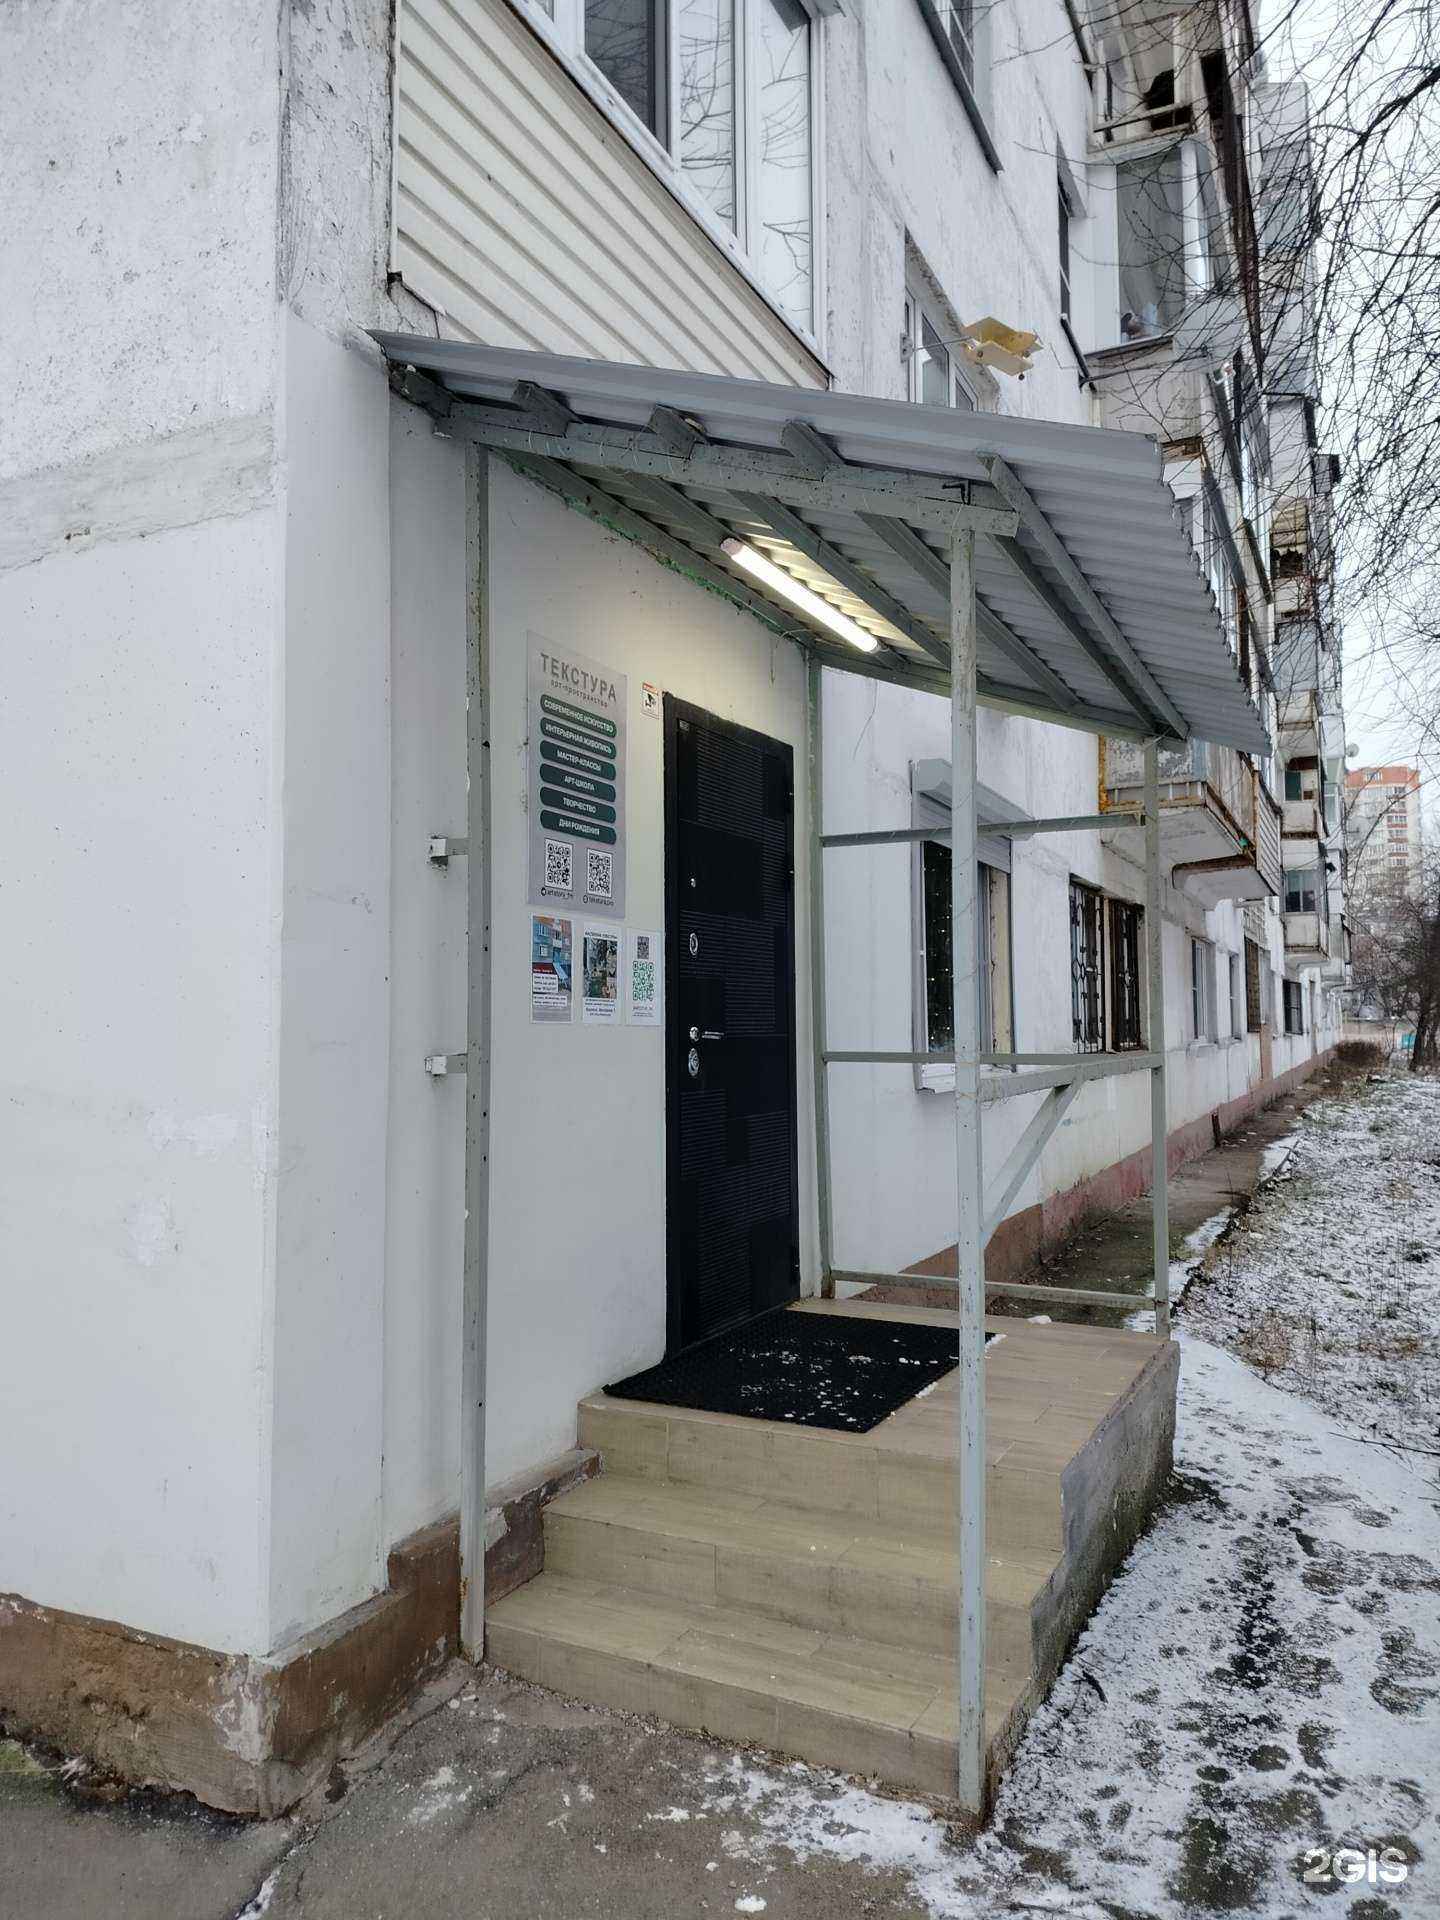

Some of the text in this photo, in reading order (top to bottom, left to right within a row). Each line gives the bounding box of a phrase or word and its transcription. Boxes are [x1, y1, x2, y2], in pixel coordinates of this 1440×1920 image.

[540, 652, 617, 703] ТЕКСТУРА
[544, 699, 583, 721] СОВРЕМЕННОЕ
[557, 749, 601, 771] МАСТЕР-КЛАССЫ
[564, 775, 595, 791] АРТ-ШКОЛА
[563, 797, 597, 813] ТВОРЧЕСТВО
[559, 818, 571, 829] ДНИ
